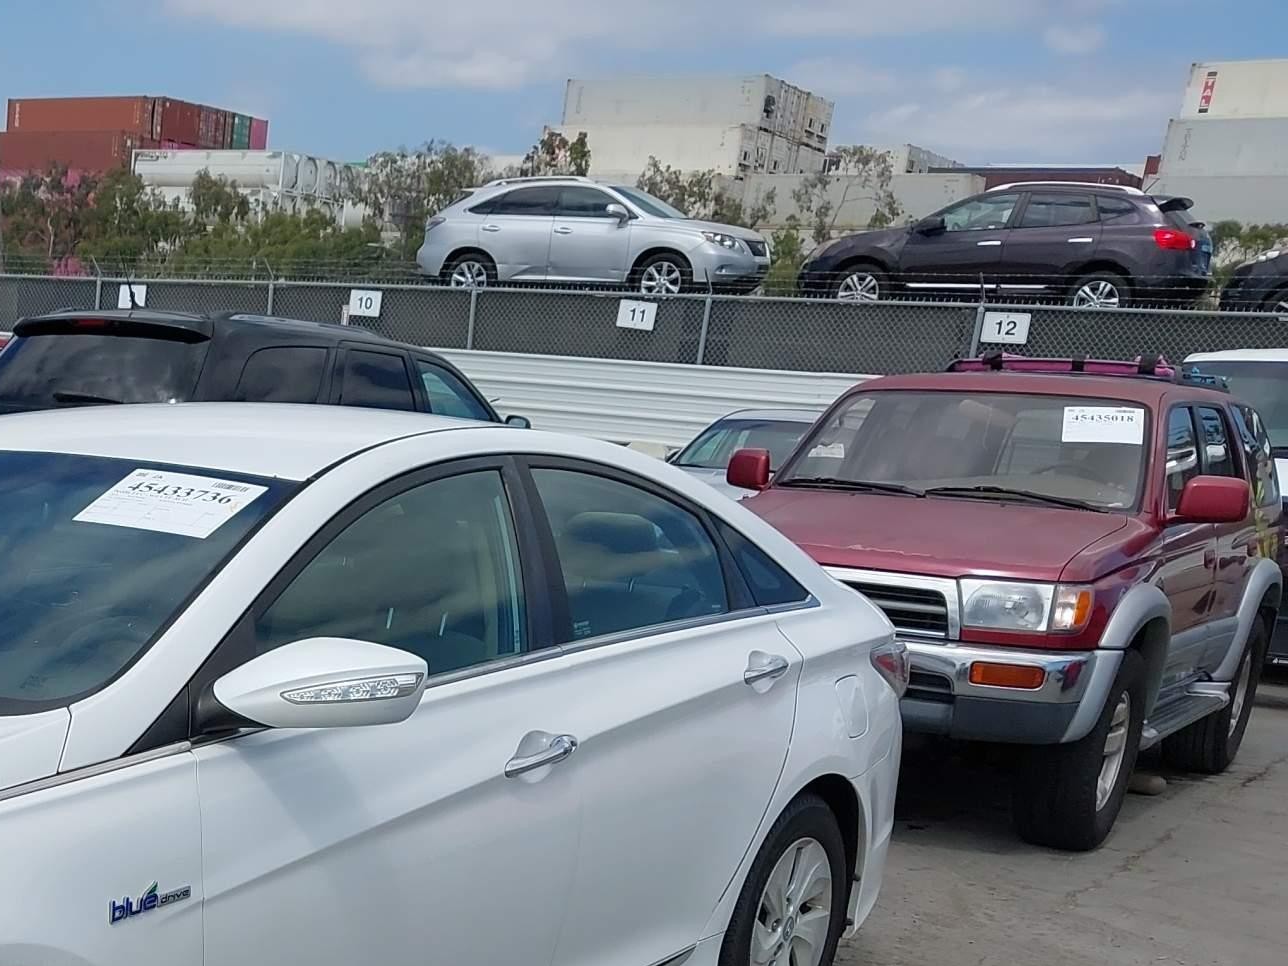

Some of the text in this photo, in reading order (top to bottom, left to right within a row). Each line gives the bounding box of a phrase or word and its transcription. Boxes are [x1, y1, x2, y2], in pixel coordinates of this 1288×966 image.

[358, 296, 373, 310] 10
[629, 307, 646, 322] 11
[995, 319, 1018, 336] 12
[1072, 414, 1134, 423] 45435018
[128, 481, 232, 505] 45433736
[109, 888, 190, 925] blue drive
